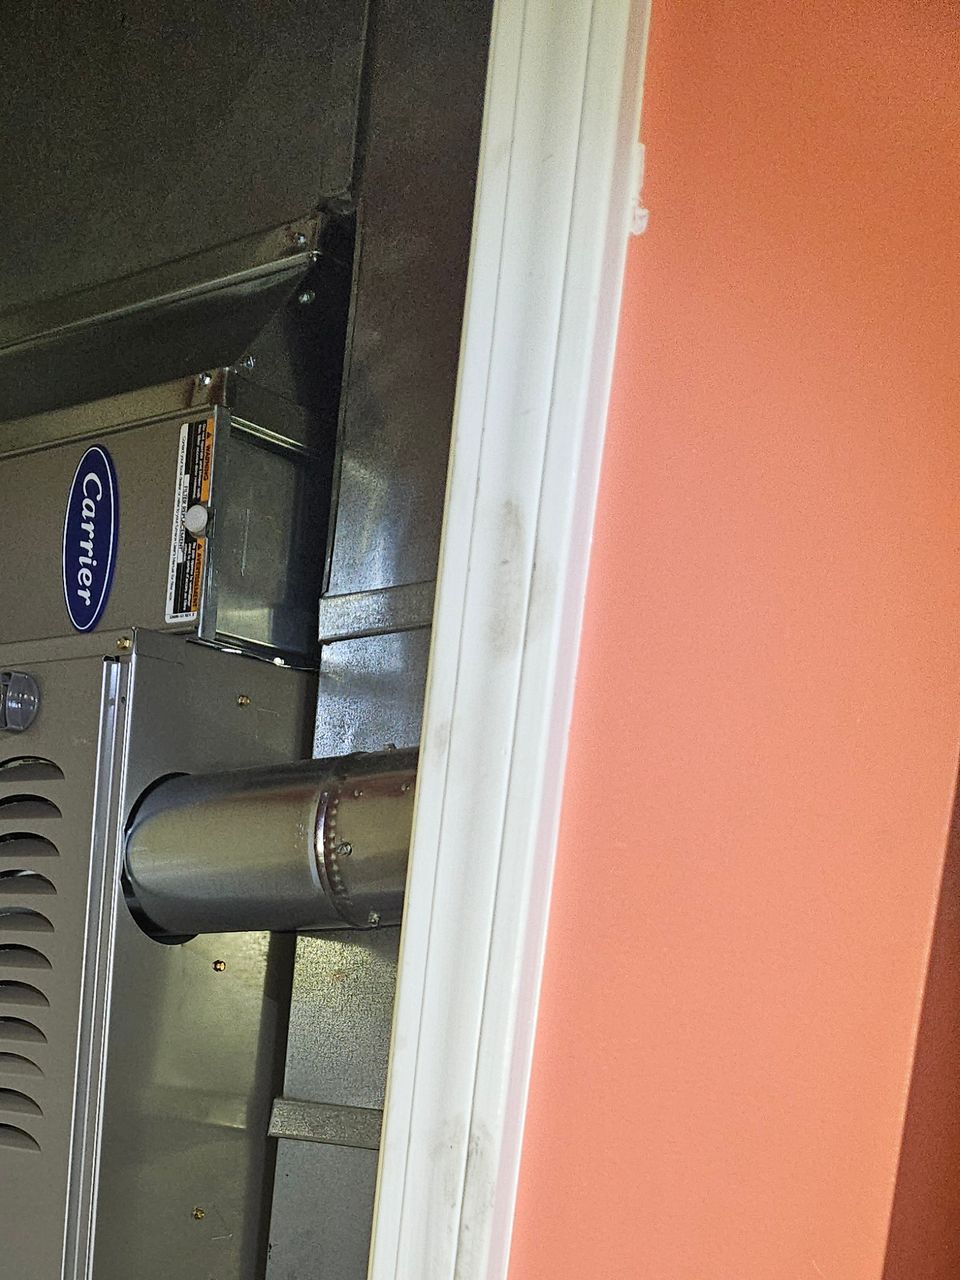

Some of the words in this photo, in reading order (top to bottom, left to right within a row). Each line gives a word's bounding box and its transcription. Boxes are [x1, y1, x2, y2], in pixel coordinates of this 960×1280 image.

[203, 444, 211, 481] WARNING
[77, 472, 103, 607] Carrier
[192, 552, 202, 607] AVERTISSEMENT
